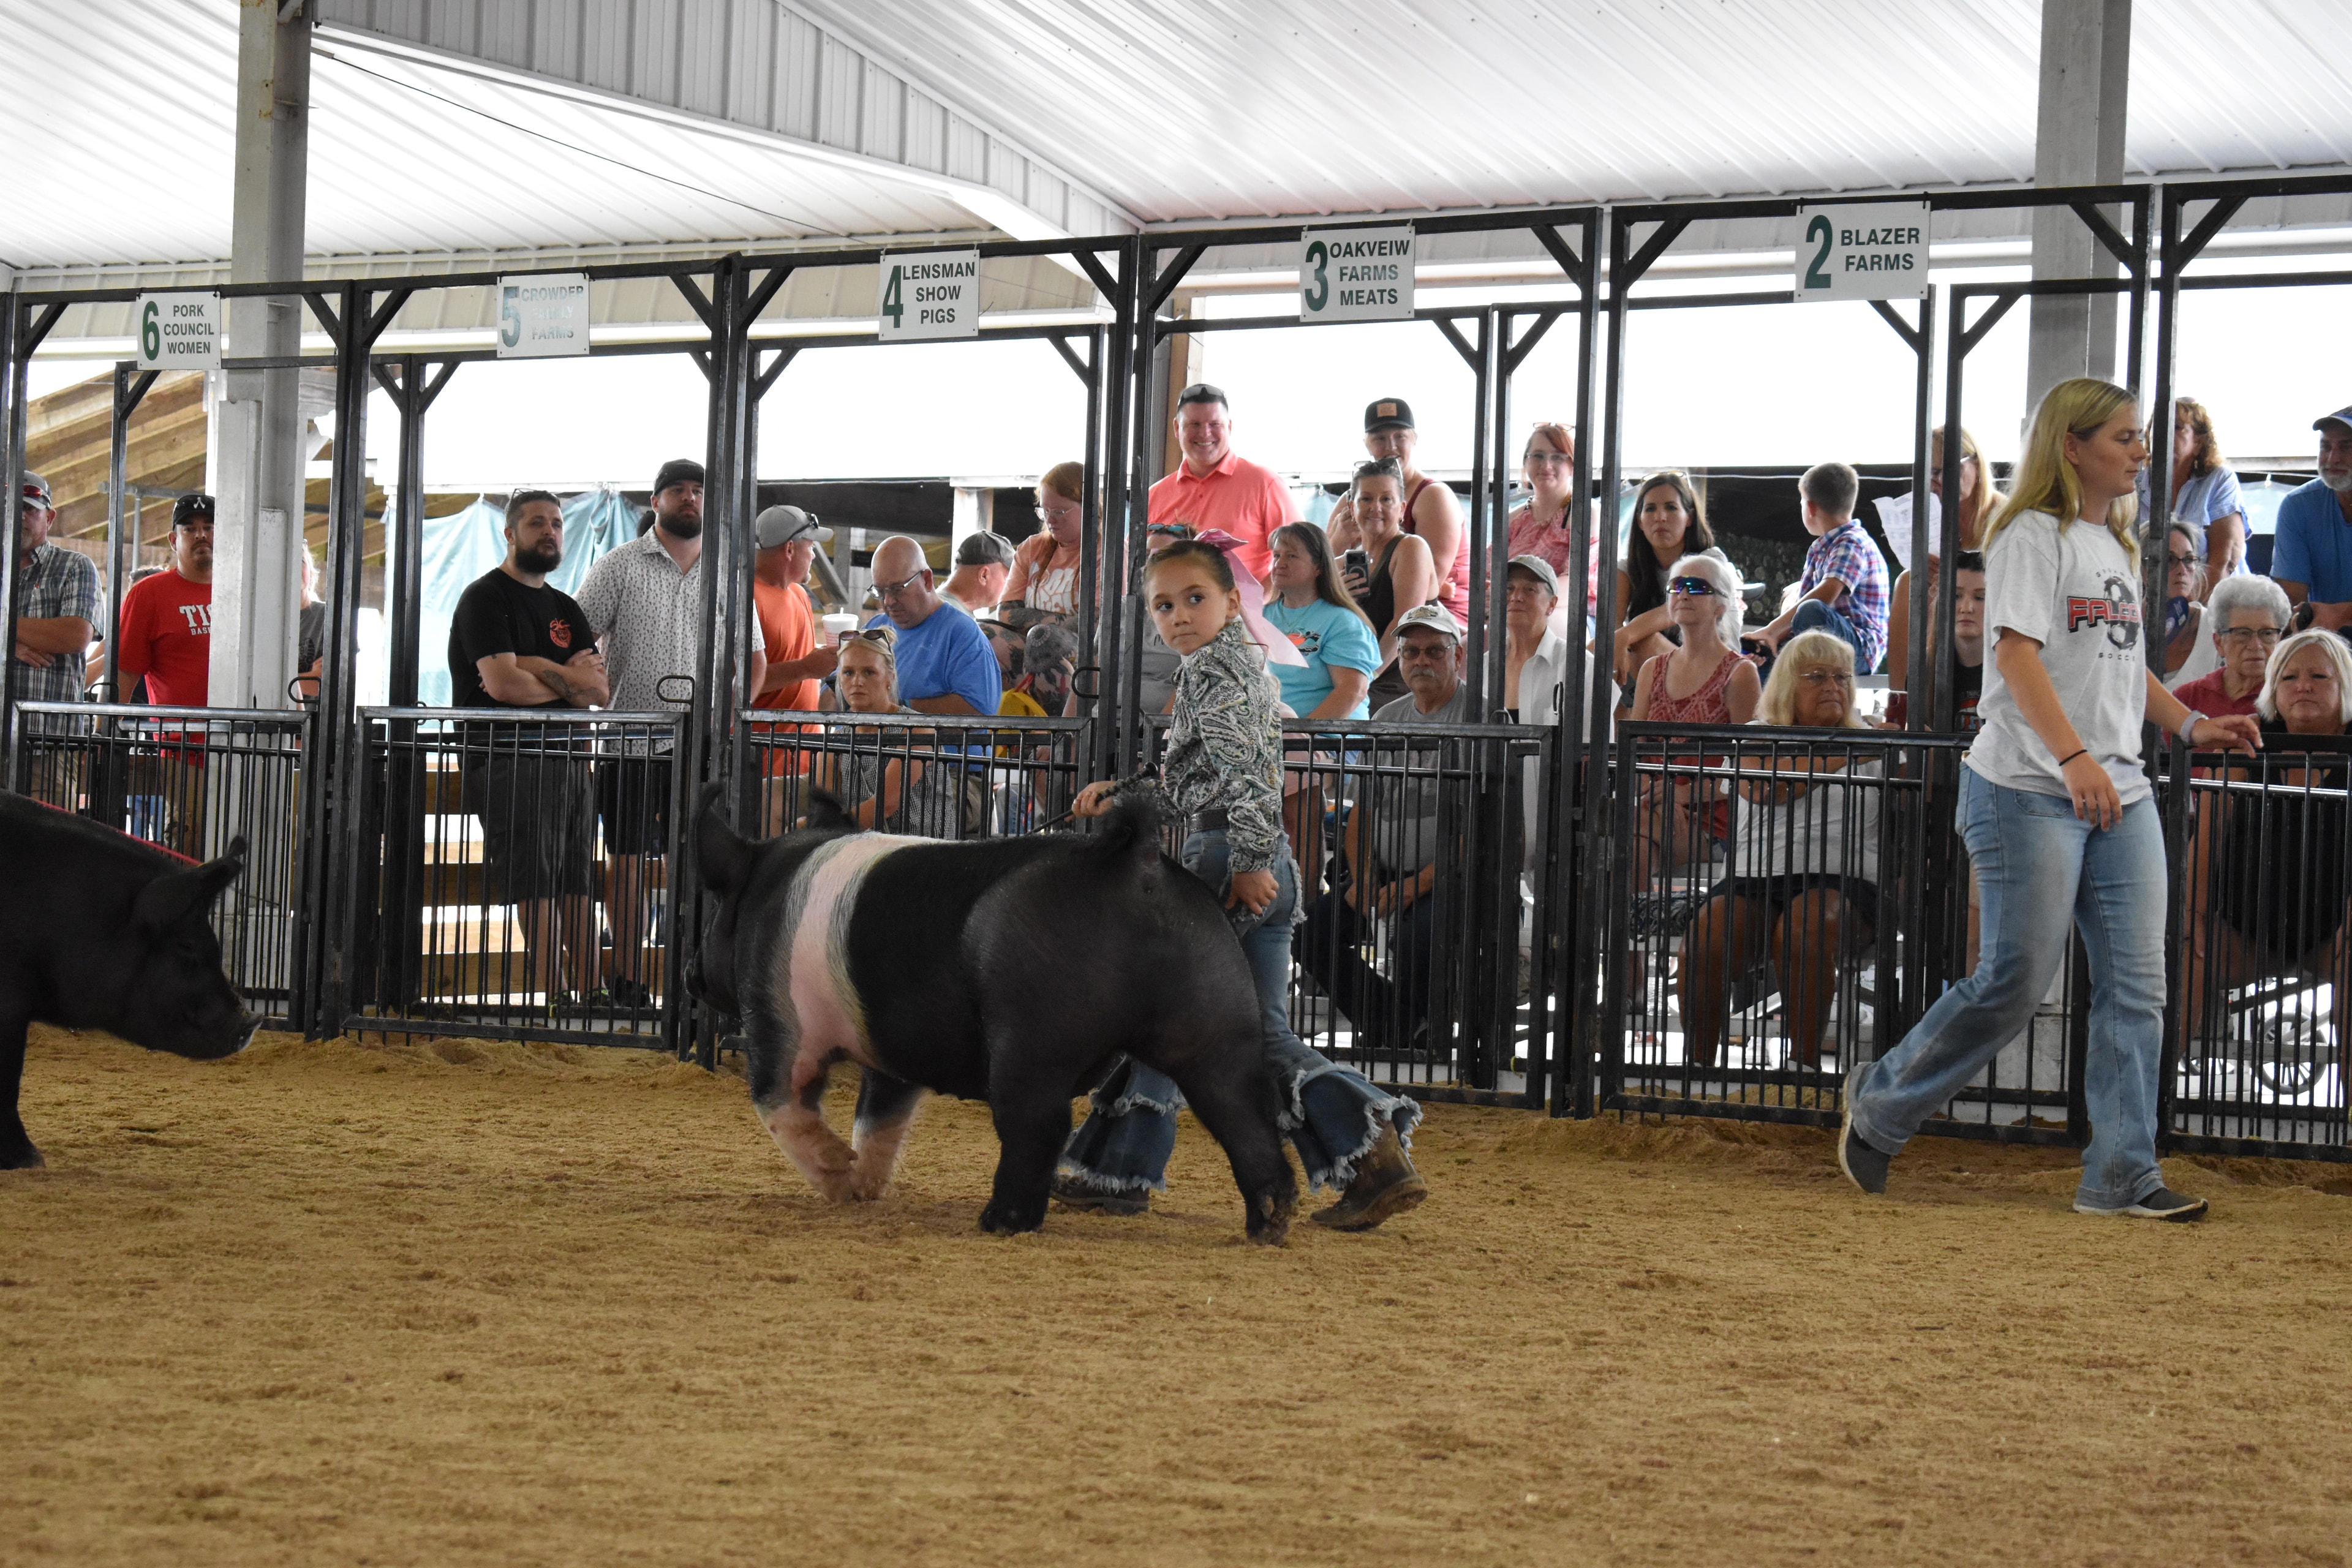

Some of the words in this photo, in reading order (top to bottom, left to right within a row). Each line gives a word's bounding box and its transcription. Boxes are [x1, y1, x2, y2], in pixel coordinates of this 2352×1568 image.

[1841, 227, 1920, 246] BLAZER
[1330, 239, 1410, 258] OAKVEIW
[1804, 214, 1833, 289] 2
[903, 262, 975, 280] LENSMAN
[1845, 253, 1914, 271] FARMS
[1305, 240, 1329, 312] 3
[1340, 264, 1398, 282] FARMS
[521, 285, 584, 302] CROWDER
[882, 265, 903, 328] 4
[916, 285, 961, 302] SHOW
[1340, 288, 1398, 306] MEATS
[173, 304, 204, 317] PORK
[502, 286, 520, 348] 5
[531, 305, 573, 319] FAMLY
[921, 307, 955, 324] PIGS
[142, 301, 160, 361] 6
[164, 323, 214, 336] COUNCIL
[532, 326, 574, 340] FARMS
[167, 342, 211, 354] WOMEN
